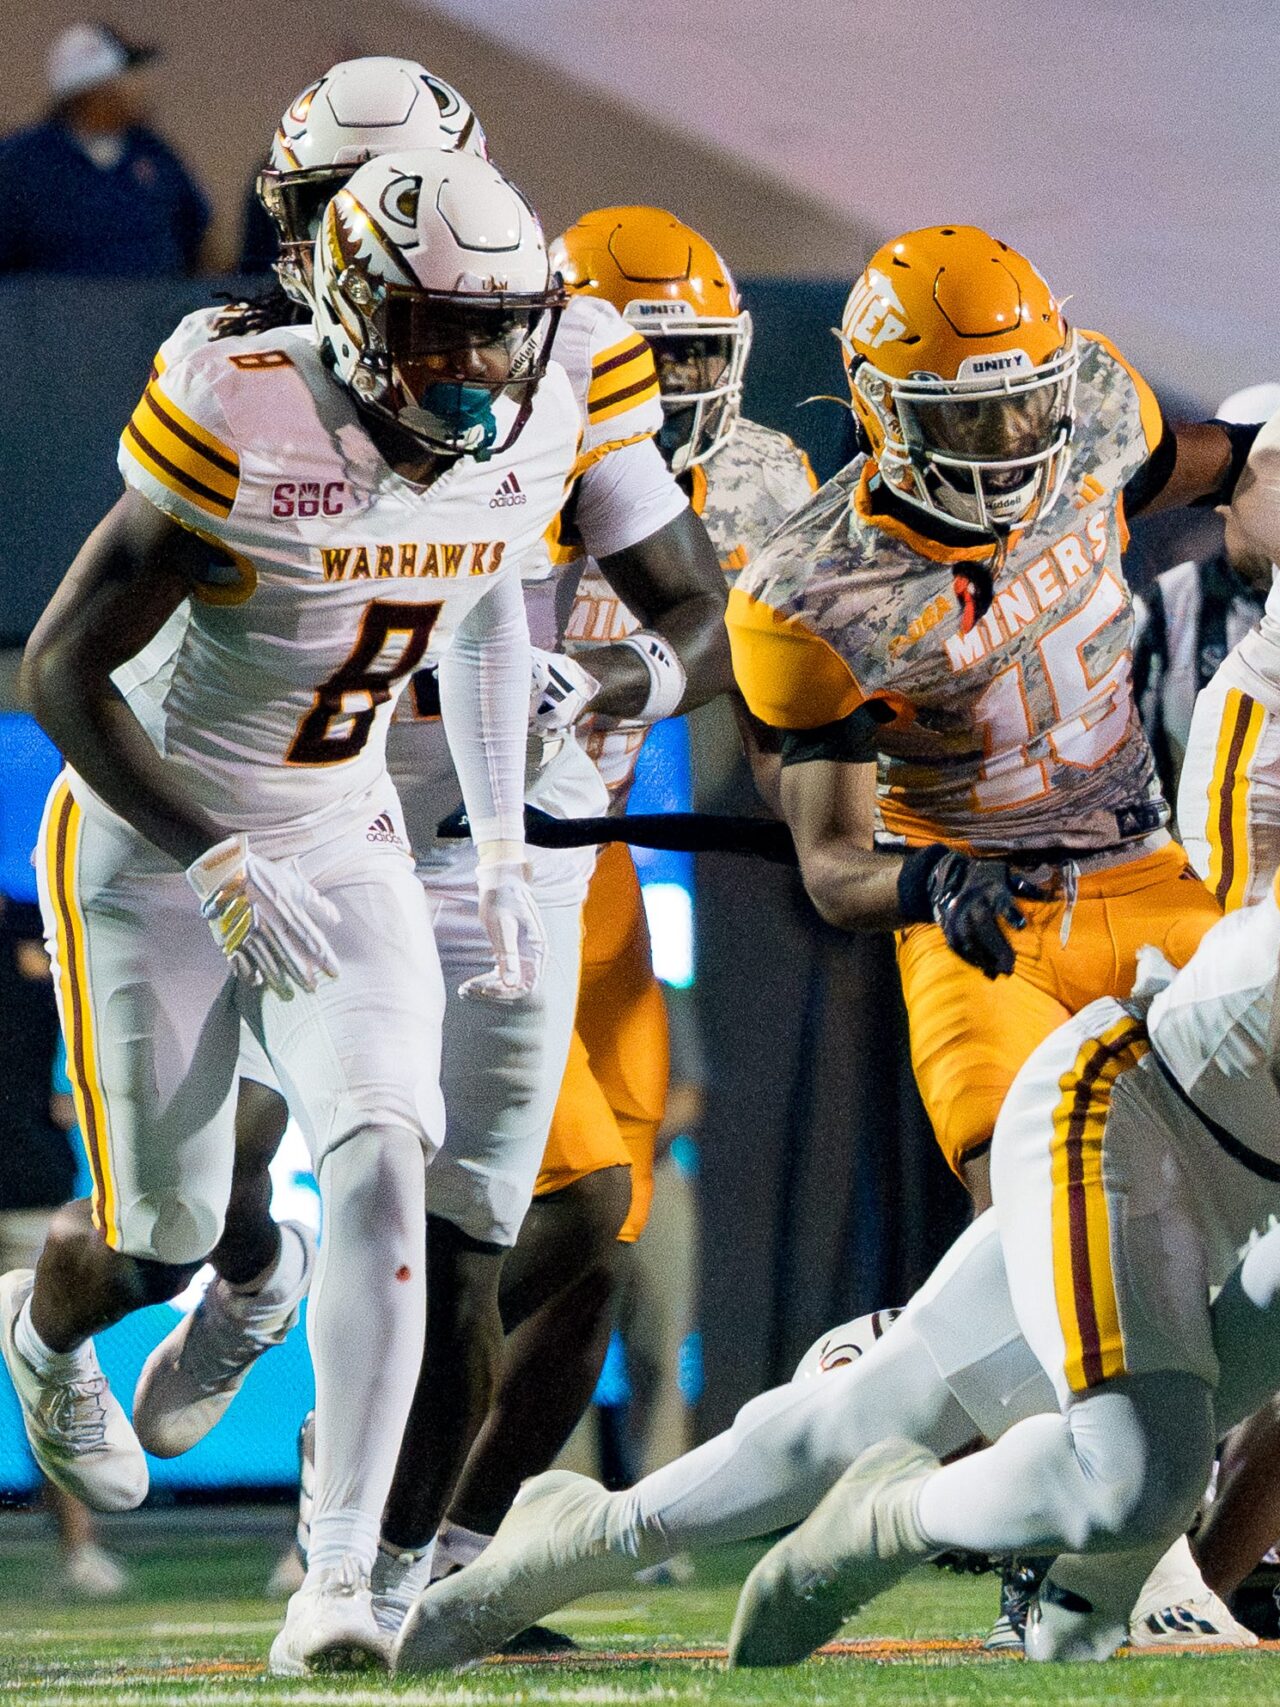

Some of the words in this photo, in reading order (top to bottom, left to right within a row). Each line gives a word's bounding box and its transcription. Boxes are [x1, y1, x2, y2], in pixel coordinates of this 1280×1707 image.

[227, 349, 295, 372] 8
[511, 338, 538, 375] iddell
[972, 354, 1023, 374] UNITY
[271, 481, 345, 519] SBC
[320, 540, 507, 583] WARHAWKS
[944, 509, 1109, 674] MINERS
[283, 597, 447, 768] 8
[972, 565, 1130, 814] 15
